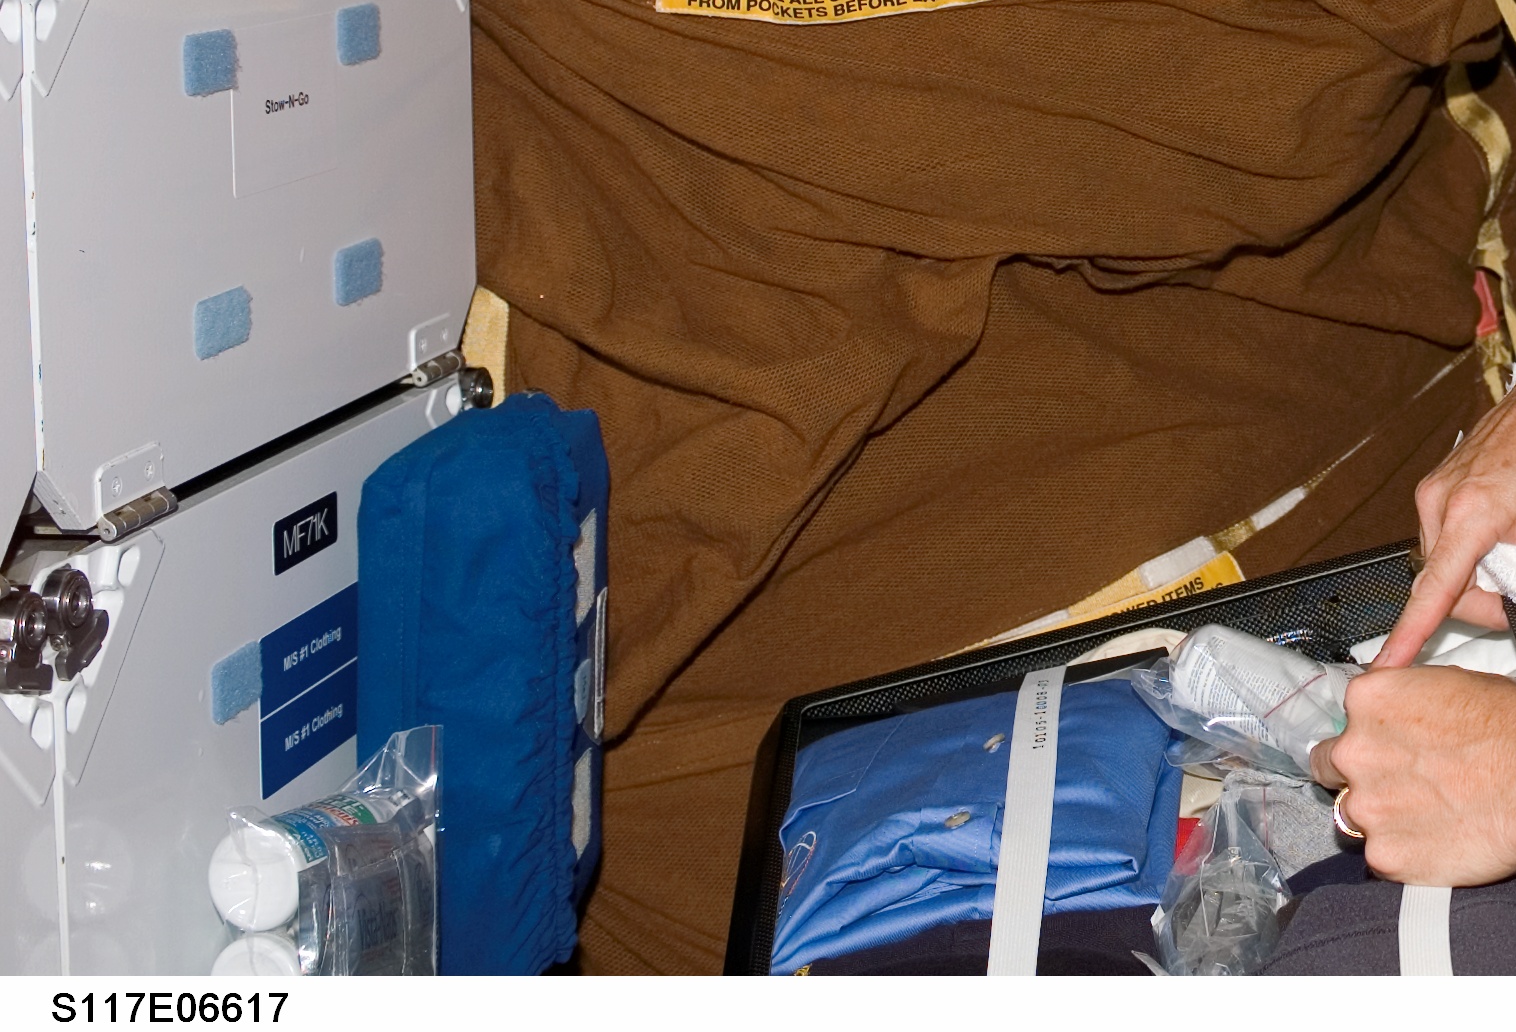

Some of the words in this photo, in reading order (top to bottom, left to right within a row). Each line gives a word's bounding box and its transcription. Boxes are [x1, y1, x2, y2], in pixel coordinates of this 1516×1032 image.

[265, 91, 310, 115] Stow-N-Go
[283, 508, 330, 559] MF71K
[283, 649, 298, 672] M/S
[299, 642, 309, 662] #1
[310, 626, 342, 656] Clothing
[284, 729, 300, 752] M/S
[301, 721, 311, 739] #1
[311, 703, 344, 733] Clothing
